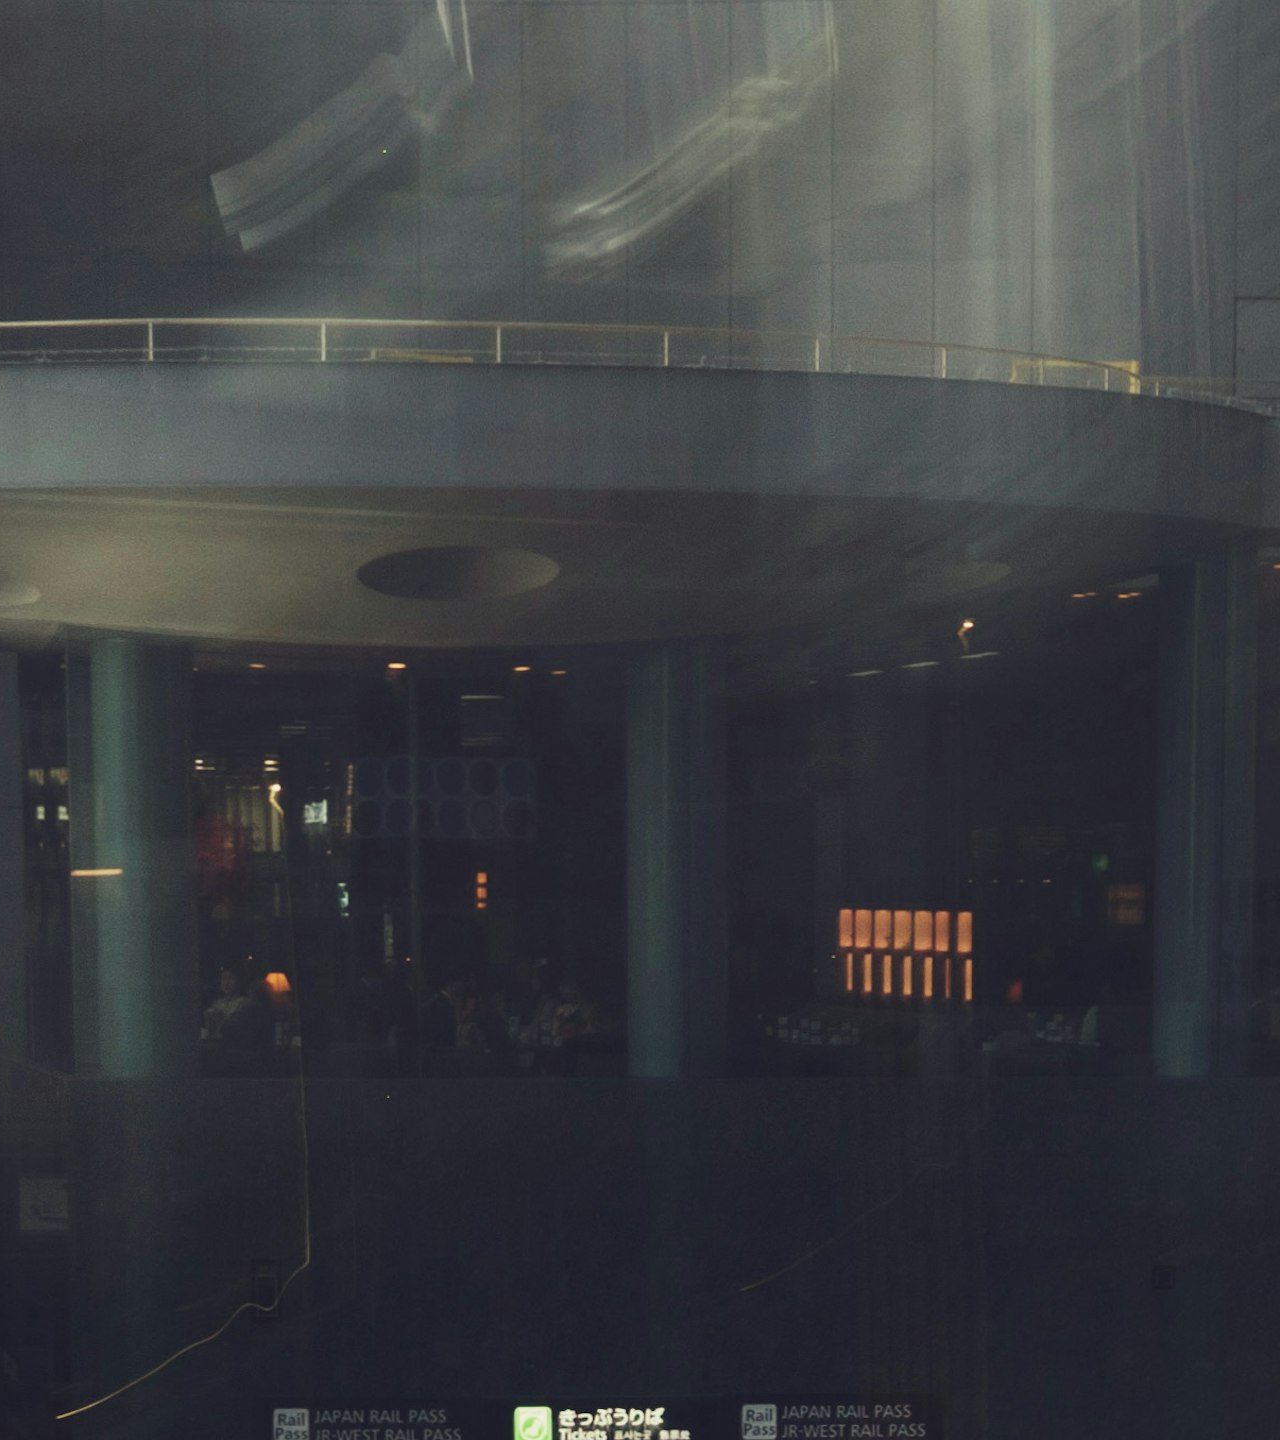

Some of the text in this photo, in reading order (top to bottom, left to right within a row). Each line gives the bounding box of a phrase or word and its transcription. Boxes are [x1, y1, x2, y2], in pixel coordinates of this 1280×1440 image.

[314, 1409, 447, 1424] JAPAN RAIL PASS
[558, 1407, 666, 1427] きっぷうりば
[746, 1408, 773, 1422] Rail
[782, 1404, 912, 1419] JAPAN RAIL PASS
[277, 1413, 306, 1427] Rail
[275, 1427, 308, 1440] Pass
[744, 1423, 777, 1437] Pass
[782, 1424, 926, 1438] JR-WEST RAIL PASS
